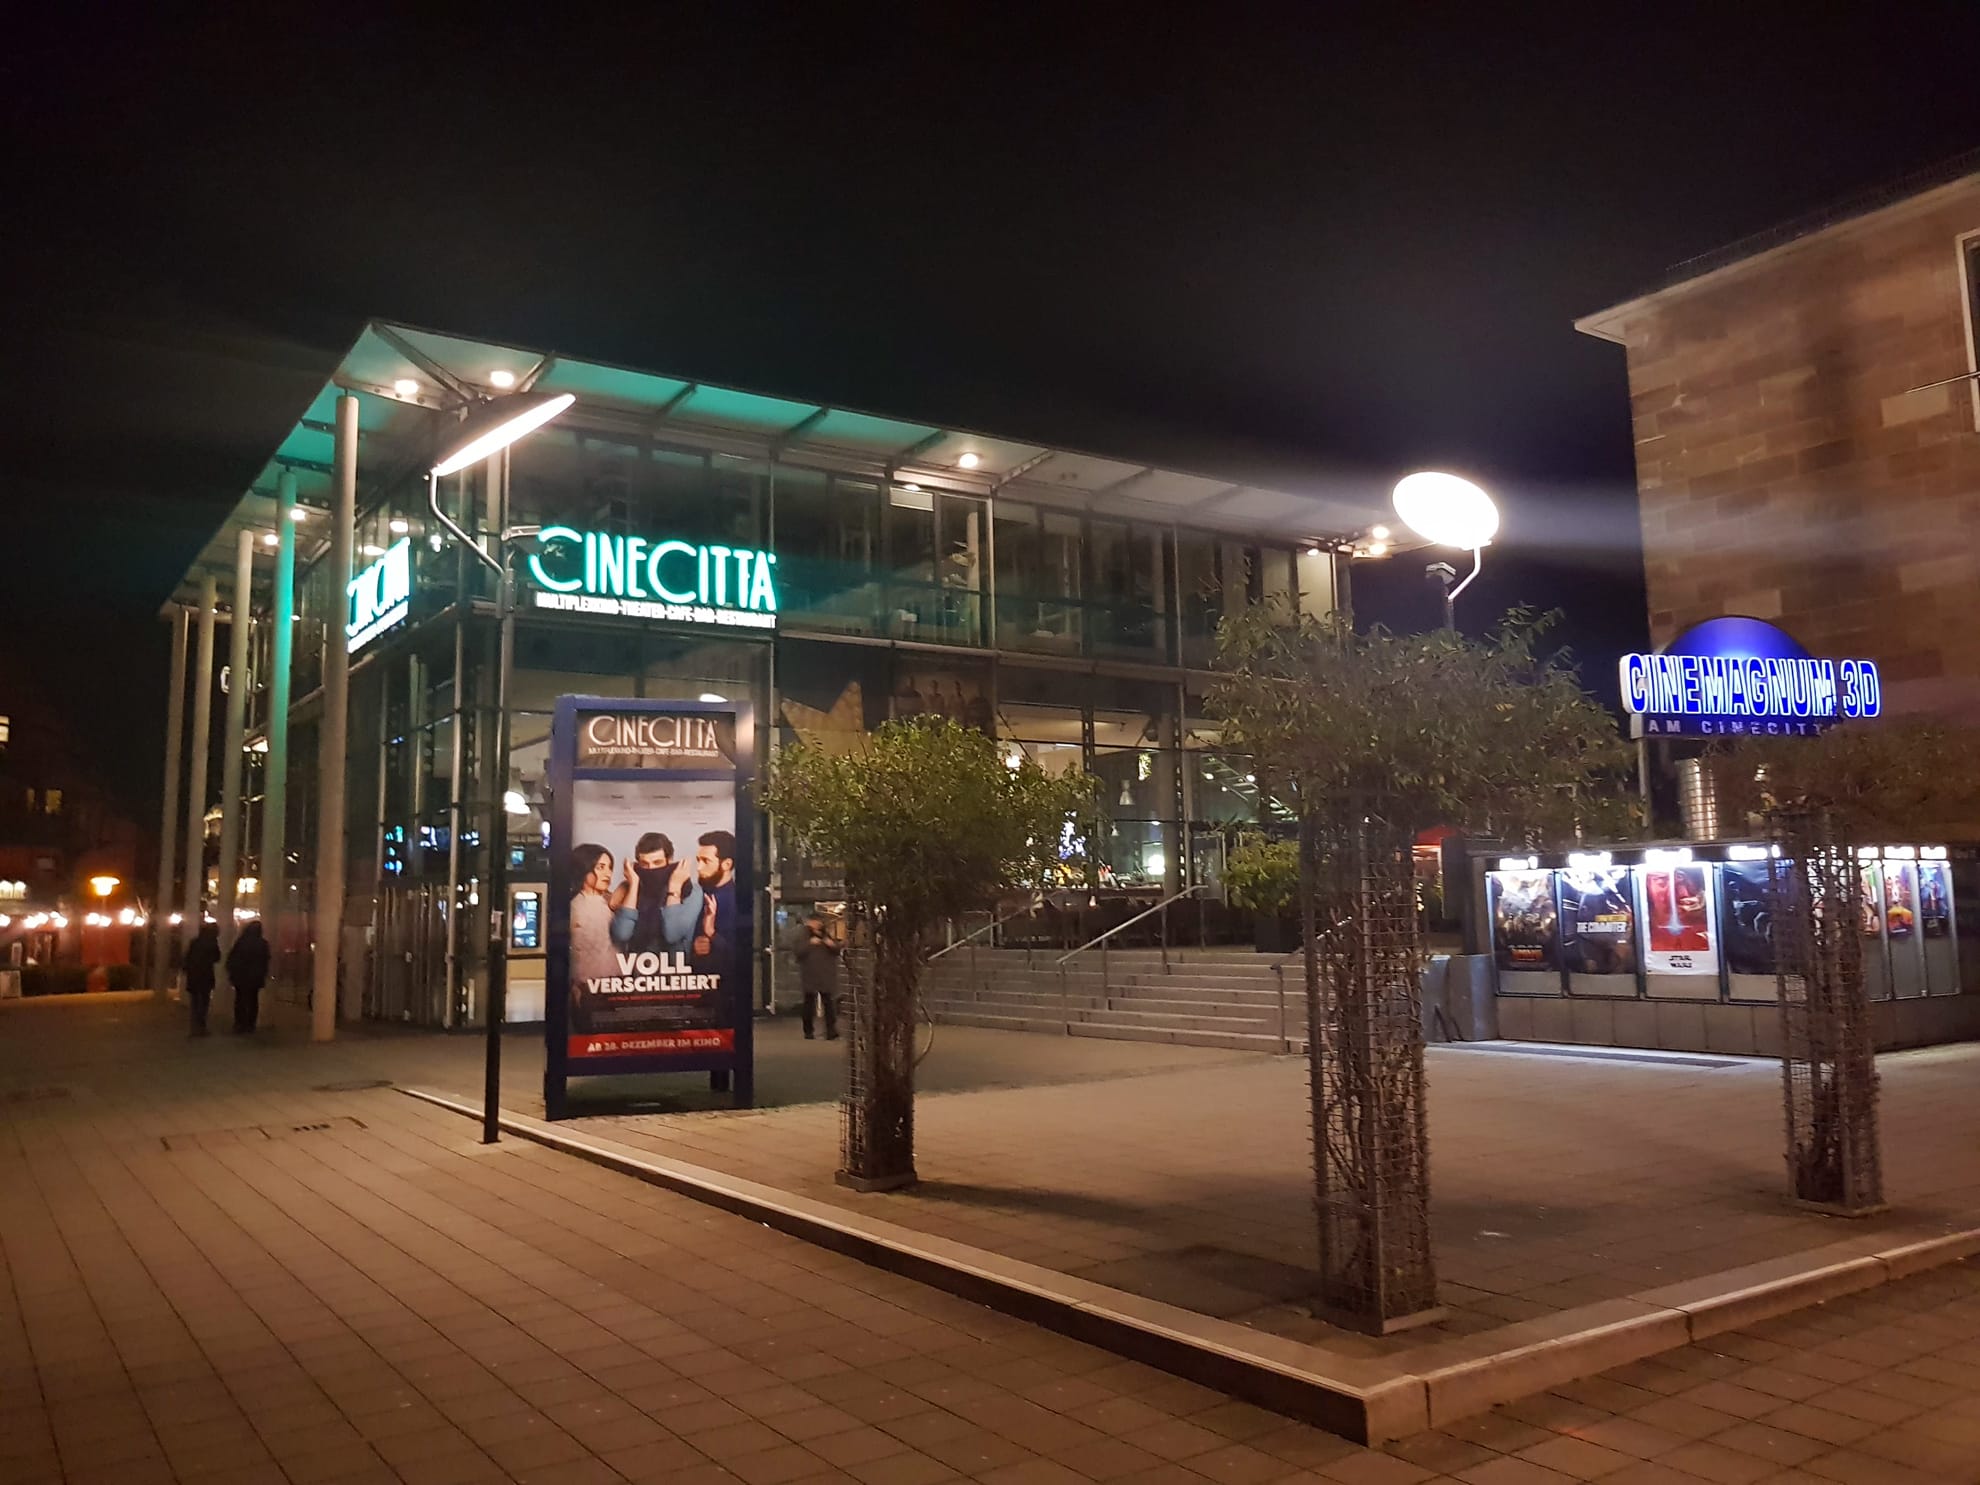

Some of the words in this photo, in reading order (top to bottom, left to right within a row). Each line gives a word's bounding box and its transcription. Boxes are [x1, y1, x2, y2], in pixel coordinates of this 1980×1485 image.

[1625, 653, 1837, 718] CINEMAGNUM
[1840, 659, 1882, 718] 3D
[1648, 720, 1681, 733] AM
[1701, 720, 1833, 736] CINECITT
[616, 951, 692, 976] VOLL
[586, 974, 721, 994] VERSCHLEIERT
[587, 1042, 602, 1053] AB
[621, 1039, 676, 1050] DEZEMBER
[677, 1038, 691, 1048] IM
[693, 1037, 721, 1047] KINO
